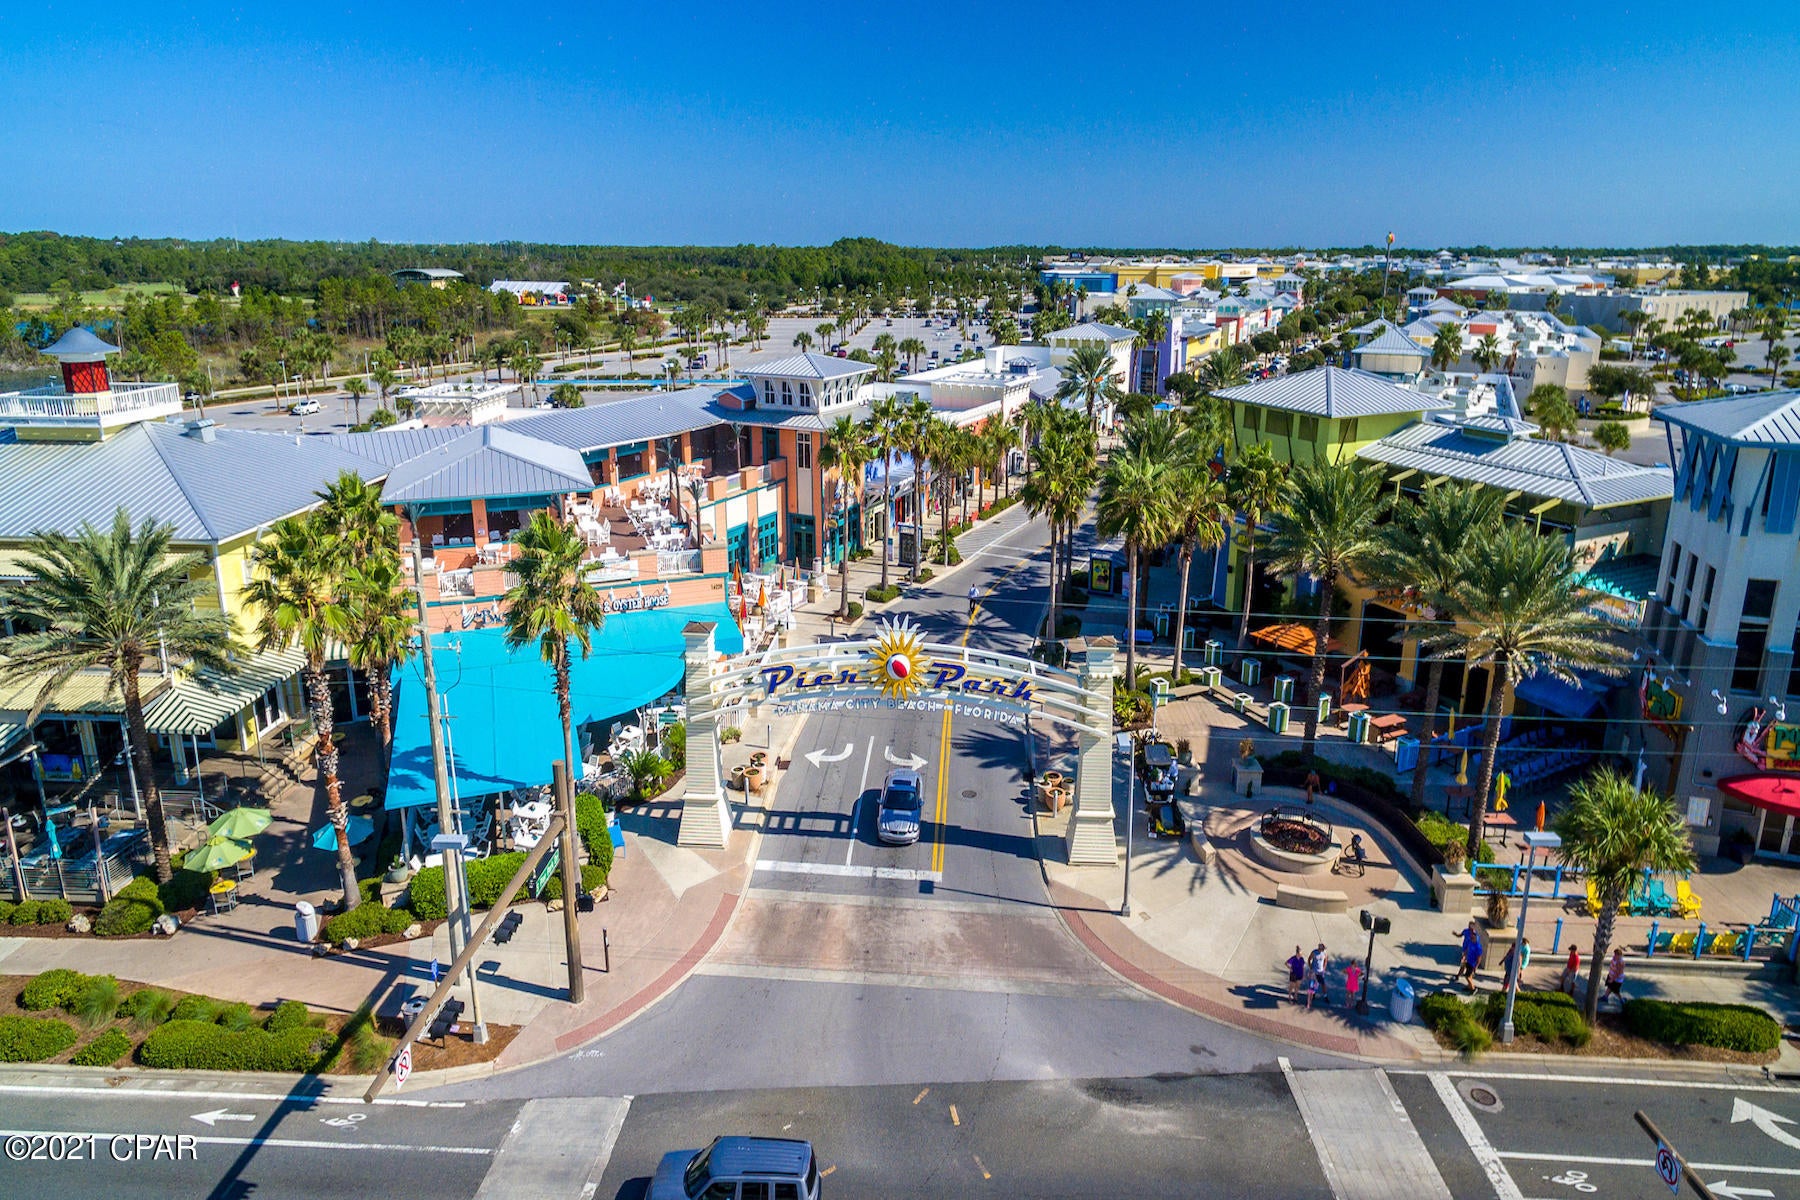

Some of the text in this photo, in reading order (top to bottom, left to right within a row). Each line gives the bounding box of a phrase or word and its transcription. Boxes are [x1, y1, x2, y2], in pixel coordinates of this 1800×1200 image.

[613, 597, 642, 611] OYSTER
[643, 594, 669, 608] HOUSE
[760, 660, 1046, 704] Pier Park
[776, 698, 1018, 725] PANAMA CITY BEACH FLORIDA
